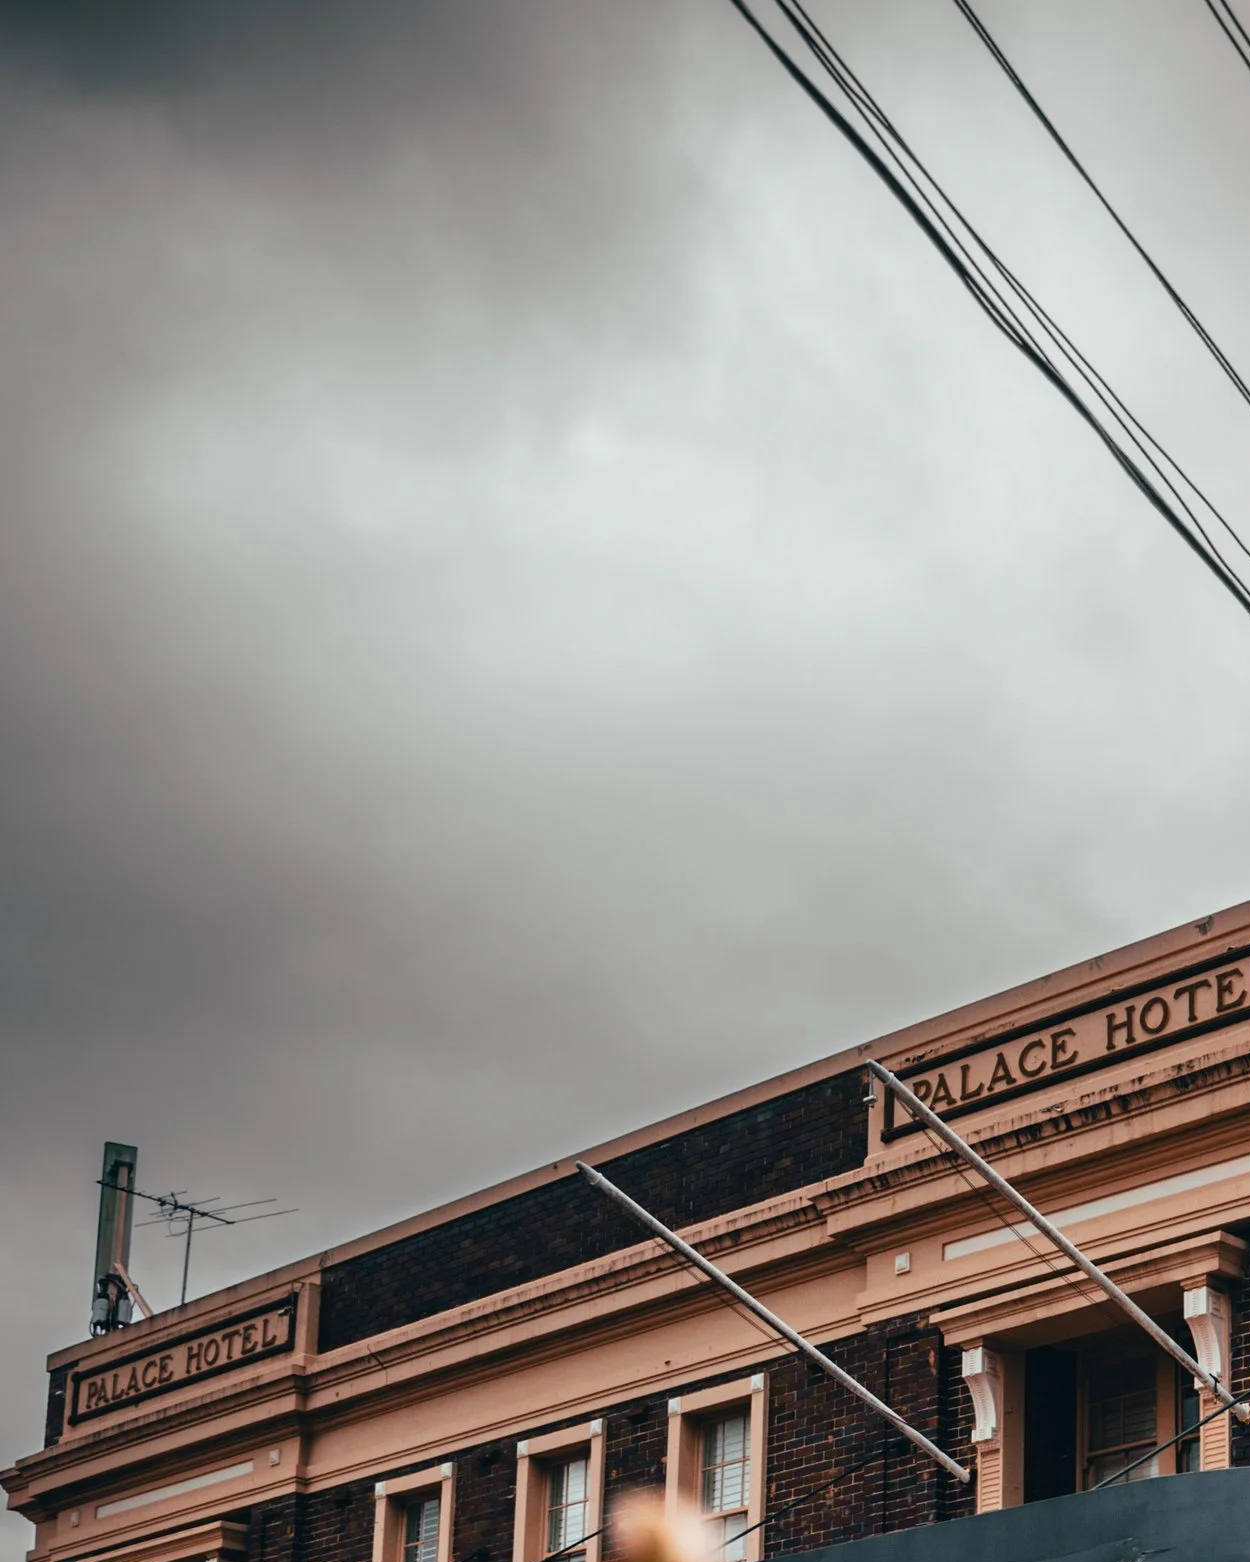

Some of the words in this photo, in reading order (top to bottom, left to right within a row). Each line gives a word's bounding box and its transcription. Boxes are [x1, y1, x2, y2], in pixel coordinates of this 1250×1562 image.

[911, 1027, 1079, 1113] PALACE
[86, 1353, 173, 1410] PALACE
[184, 1318, 277, 1376] HOTEL
